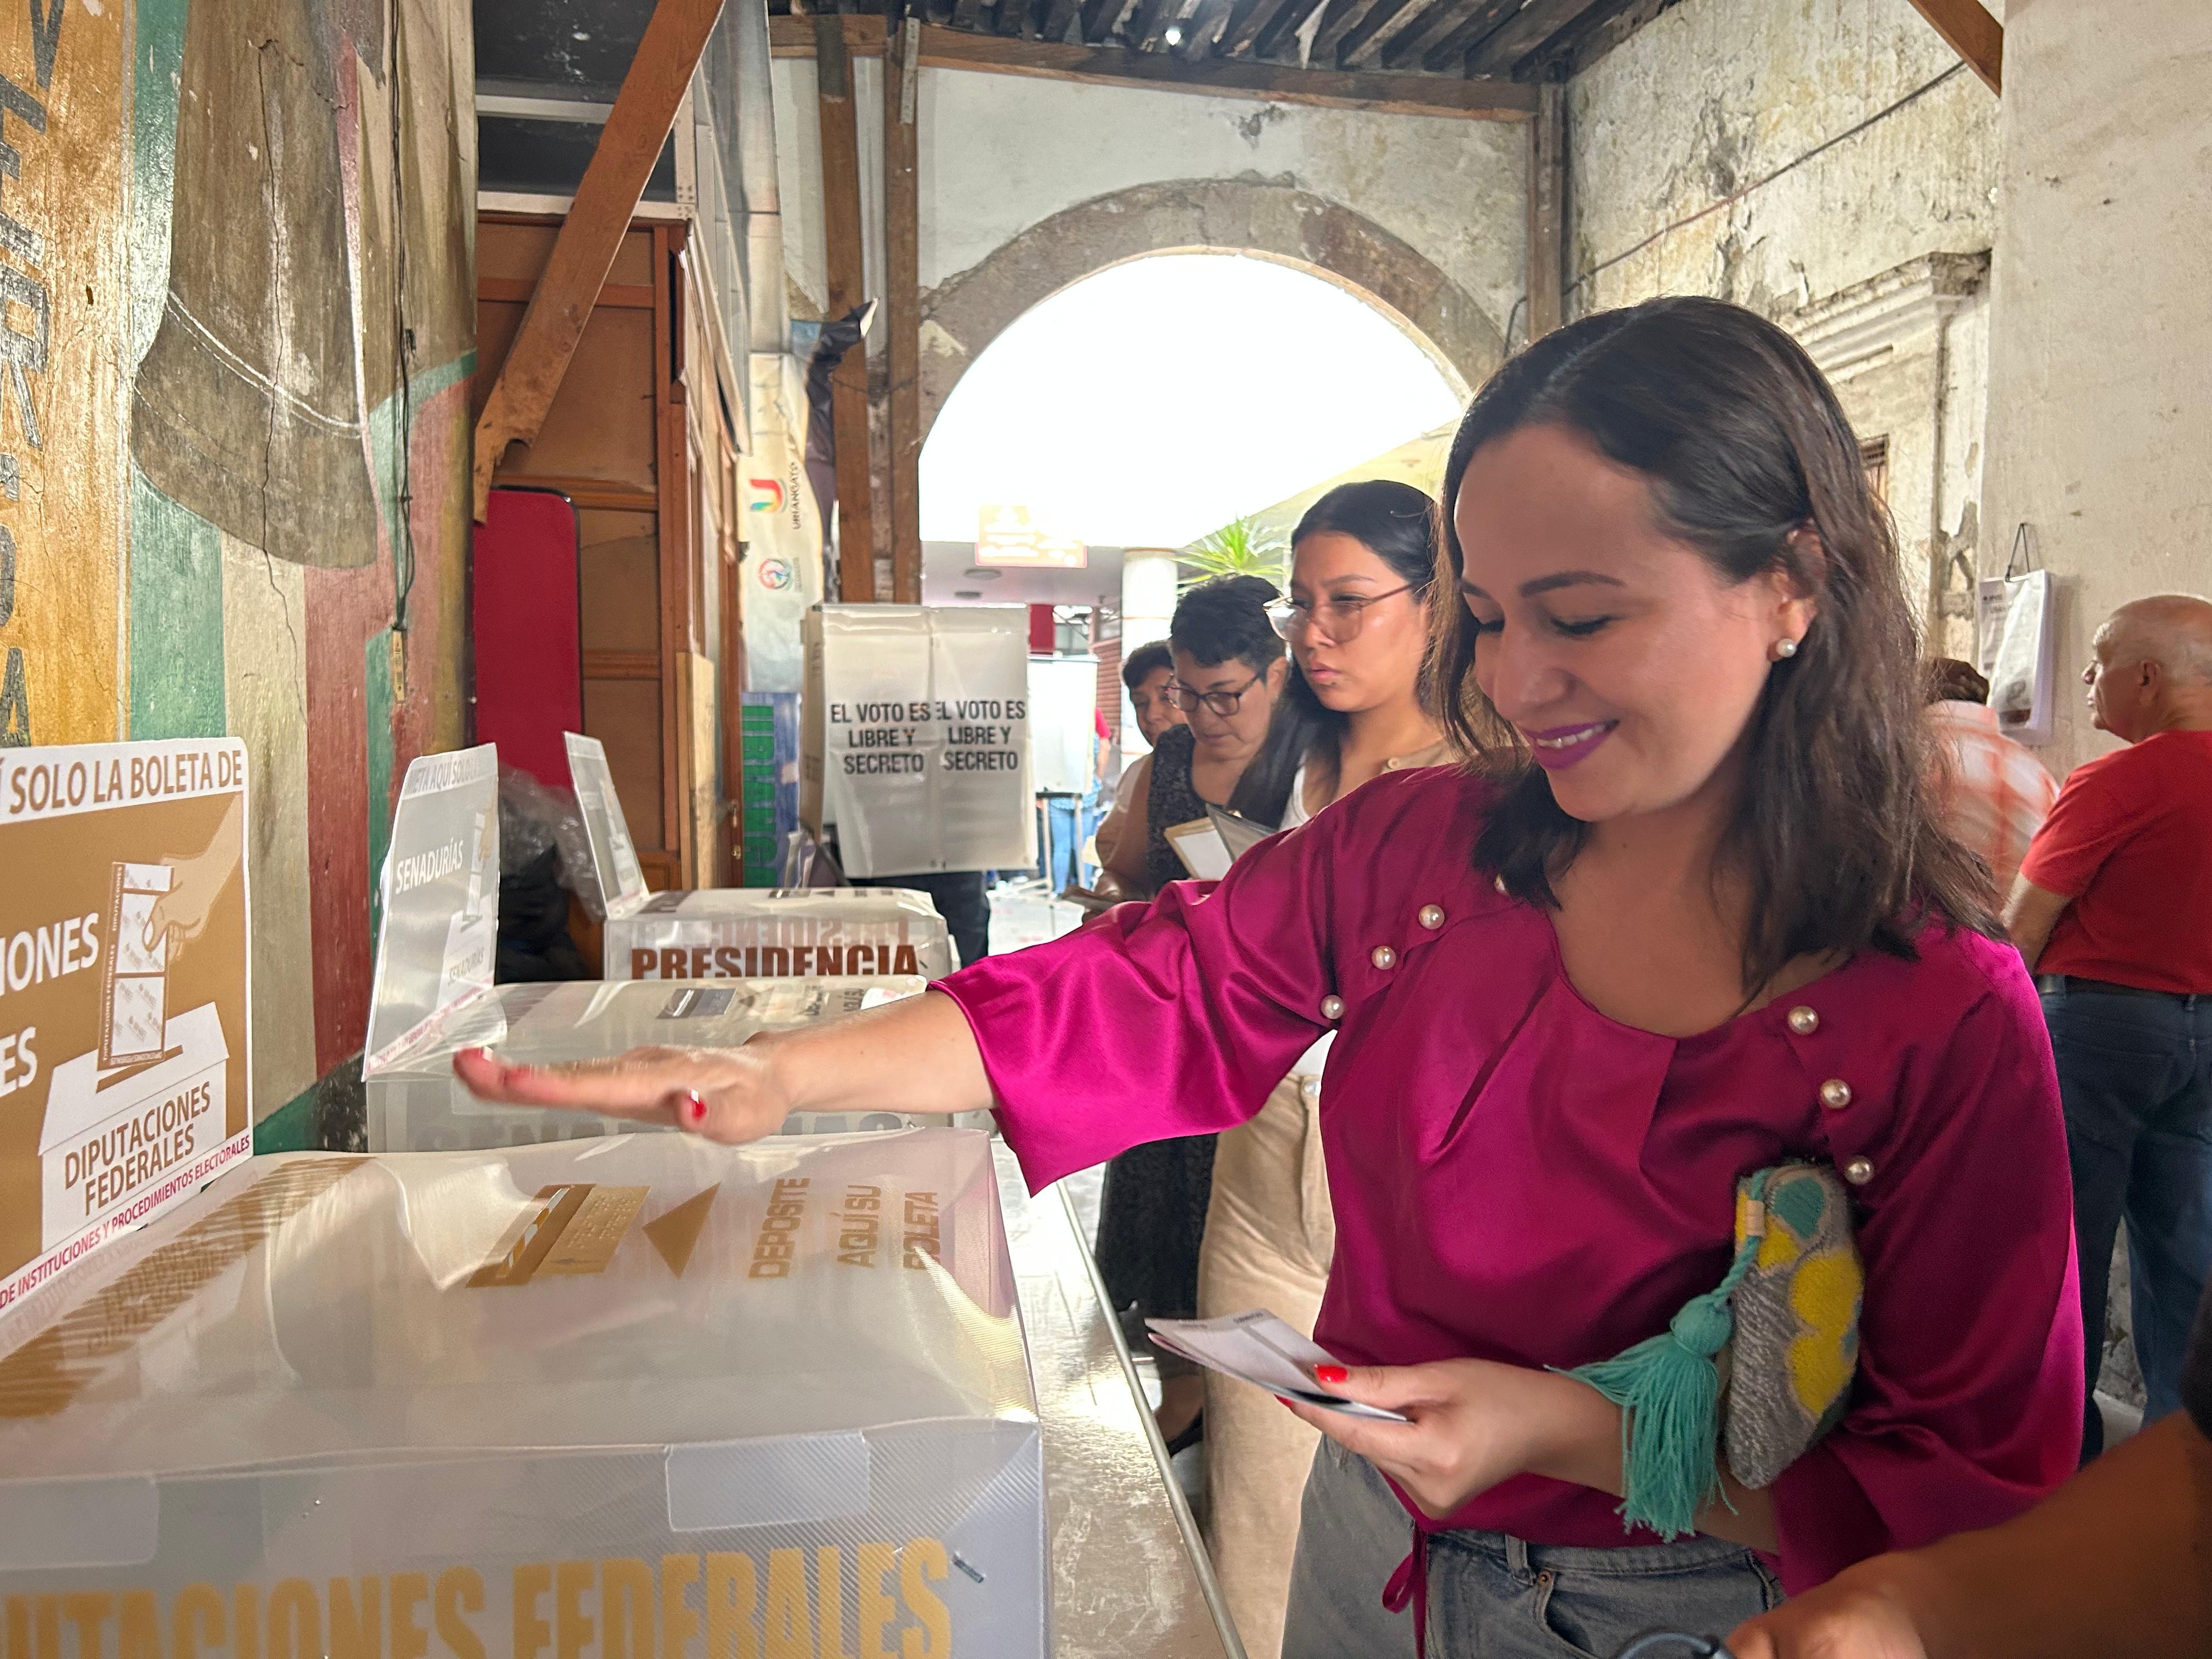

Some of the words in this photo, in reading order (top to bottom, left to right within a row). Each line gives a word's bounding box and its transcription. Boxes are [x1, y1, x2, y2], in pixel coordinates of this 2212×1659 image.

[831, 704, 852, 723] EL
[856, 703, 904, 723] VOTO
[909, 703, 931, 722] ES
[849, 729, 900, 748] LIBRE
[904, 728, 916, 747] Y
[948, 726, 996, 745] LIBRE
[1000, 726, 1011, 744] Y
[956, 701, 1001, 720] VOTO
[1006, 700, 1025, 720] ES
[9, 761, 86, 814] SOLO
[93, 759, 123, 804] LA
[130, 752, 213, 799] BOLETA
[218, 749, 243, 788] DE
[844, 753, 924, 775] SECRETO
[944, 751, 1019, 771] SECRETO
[395, 837, 464, 895] SENADURÍAS
[631, 945, 918, 980] PRESIDENCIA
[0, 1026, 37, 1097] ES
[65, 1081, 211, 1190] DIPUTACIONES
[85, 1124, 195, 1216] FEDERALES
[844, 1184, 882, 1211] SU
[0, 1283, 15, 1309] DE
[18, 1227, 101, 1296] INSTITUCIONES
[103, 1221, 110, 1238] Y
[112, 1168, 194, 1233] PROCEDIMIENTOS
[195, 1135, 250, 1181] ELECTORALES
[748, 1177, 811, 1278] DEPOSITE
[829, 1211, 879, 1268] AQUÍ
[903, 1192, 941, 1271] BOLETA
[513, 1538, 952, 1659] FEDERALES
